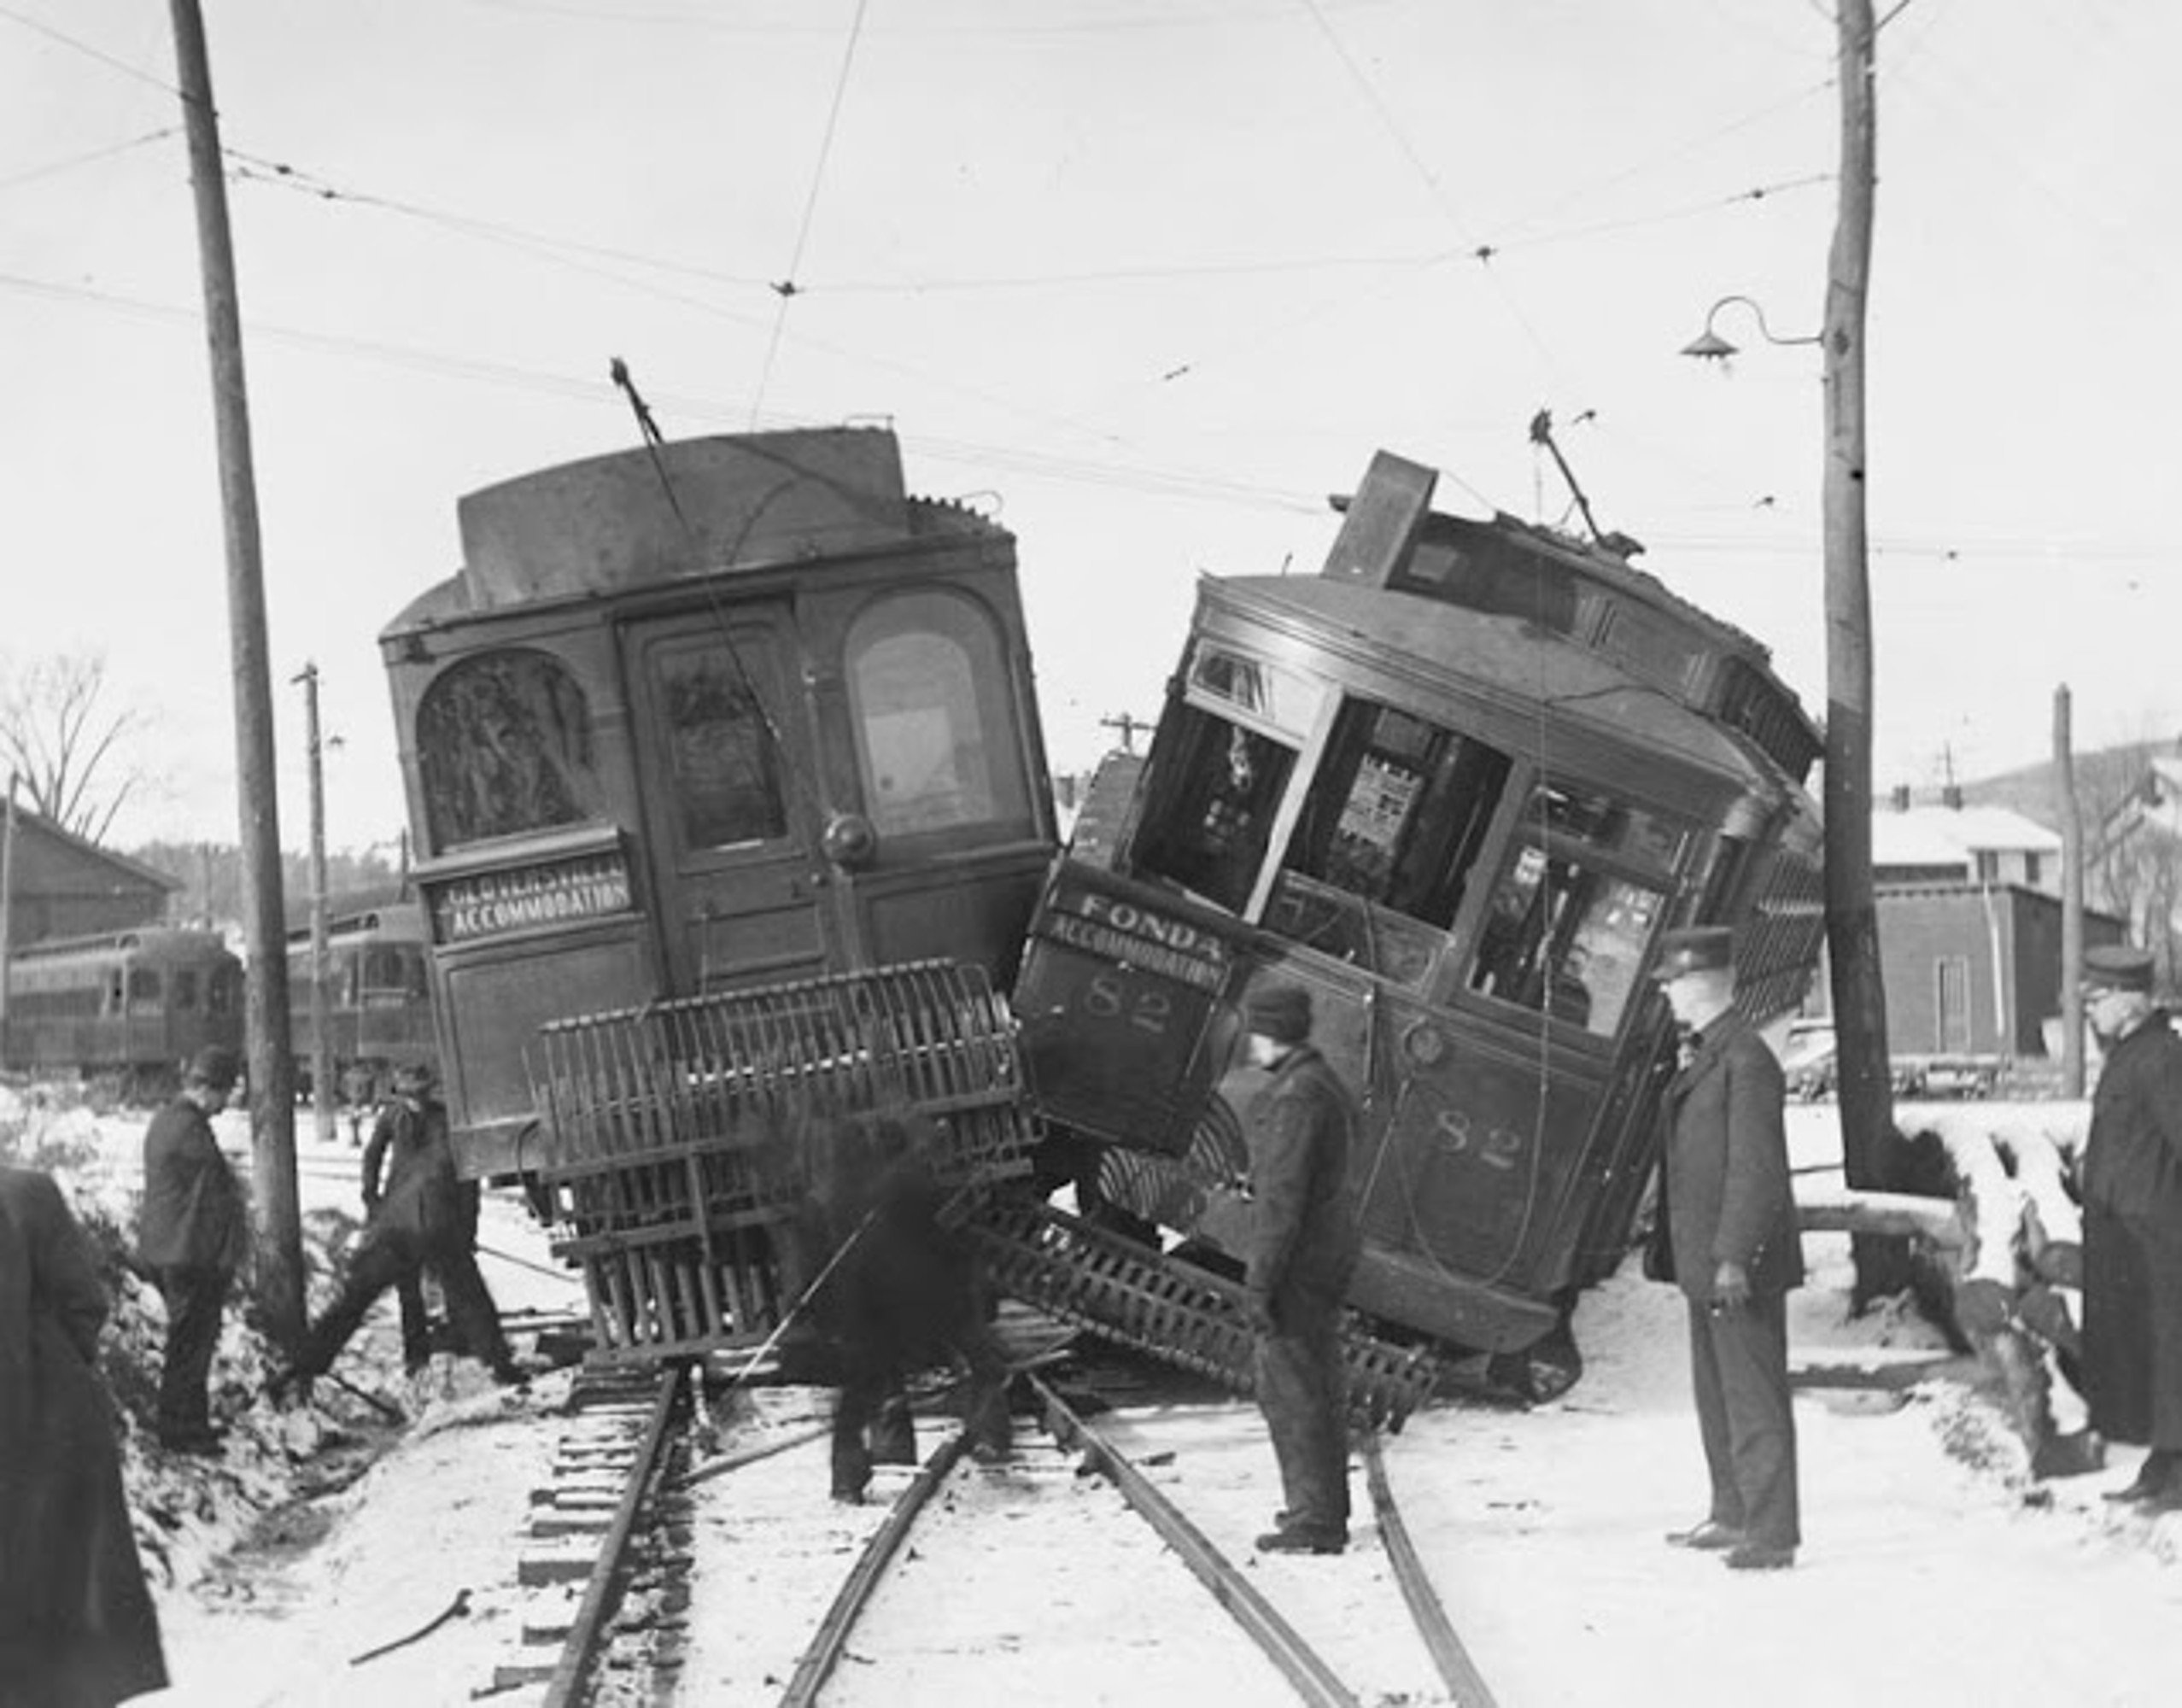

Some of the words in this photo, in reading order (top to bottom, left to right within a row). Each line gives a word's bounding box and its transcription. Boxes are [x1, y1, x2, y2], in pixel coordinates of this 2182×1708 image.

[453, 883, 629, 934] ACCOMMODATION
[1081, 894, 1221, 960] FONDA
[1083, 978, 1170, 1032] 82
[1438, 1110, 1522, 1170] 82
